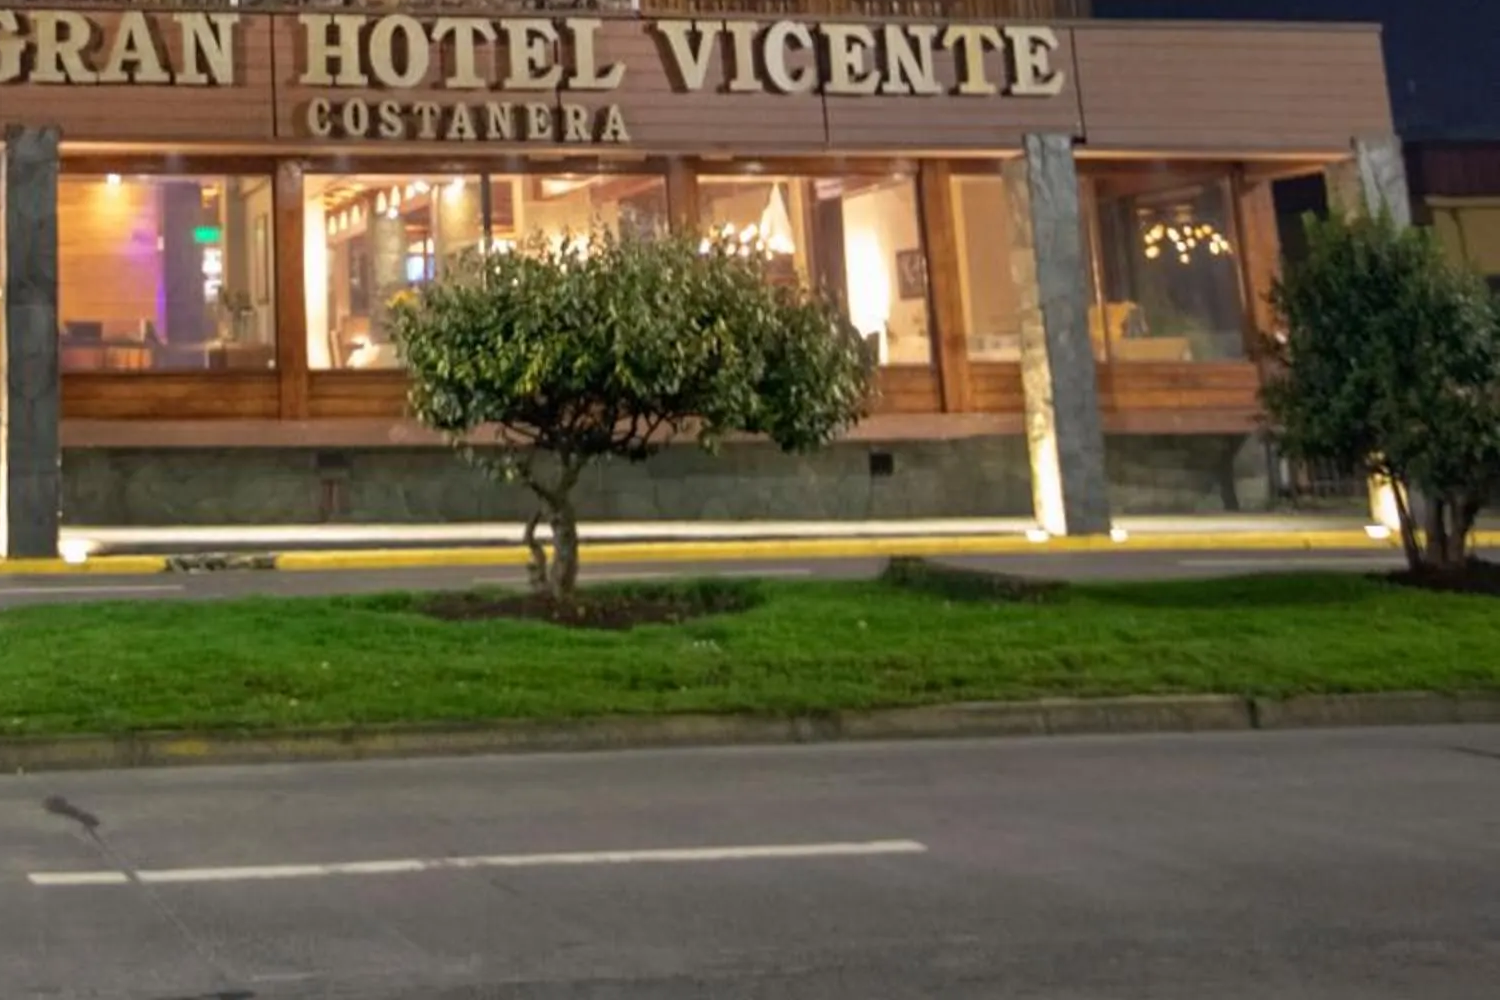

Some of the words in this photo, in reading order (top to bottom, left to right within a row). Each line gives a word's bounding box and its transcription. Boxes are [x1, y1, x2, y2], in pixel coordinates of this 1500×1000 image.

[298, 13, 627, 89] HOTEL
[656, 19, 1065, 96] VICENTE
[307, 97, 631, 142] COSTANERA
